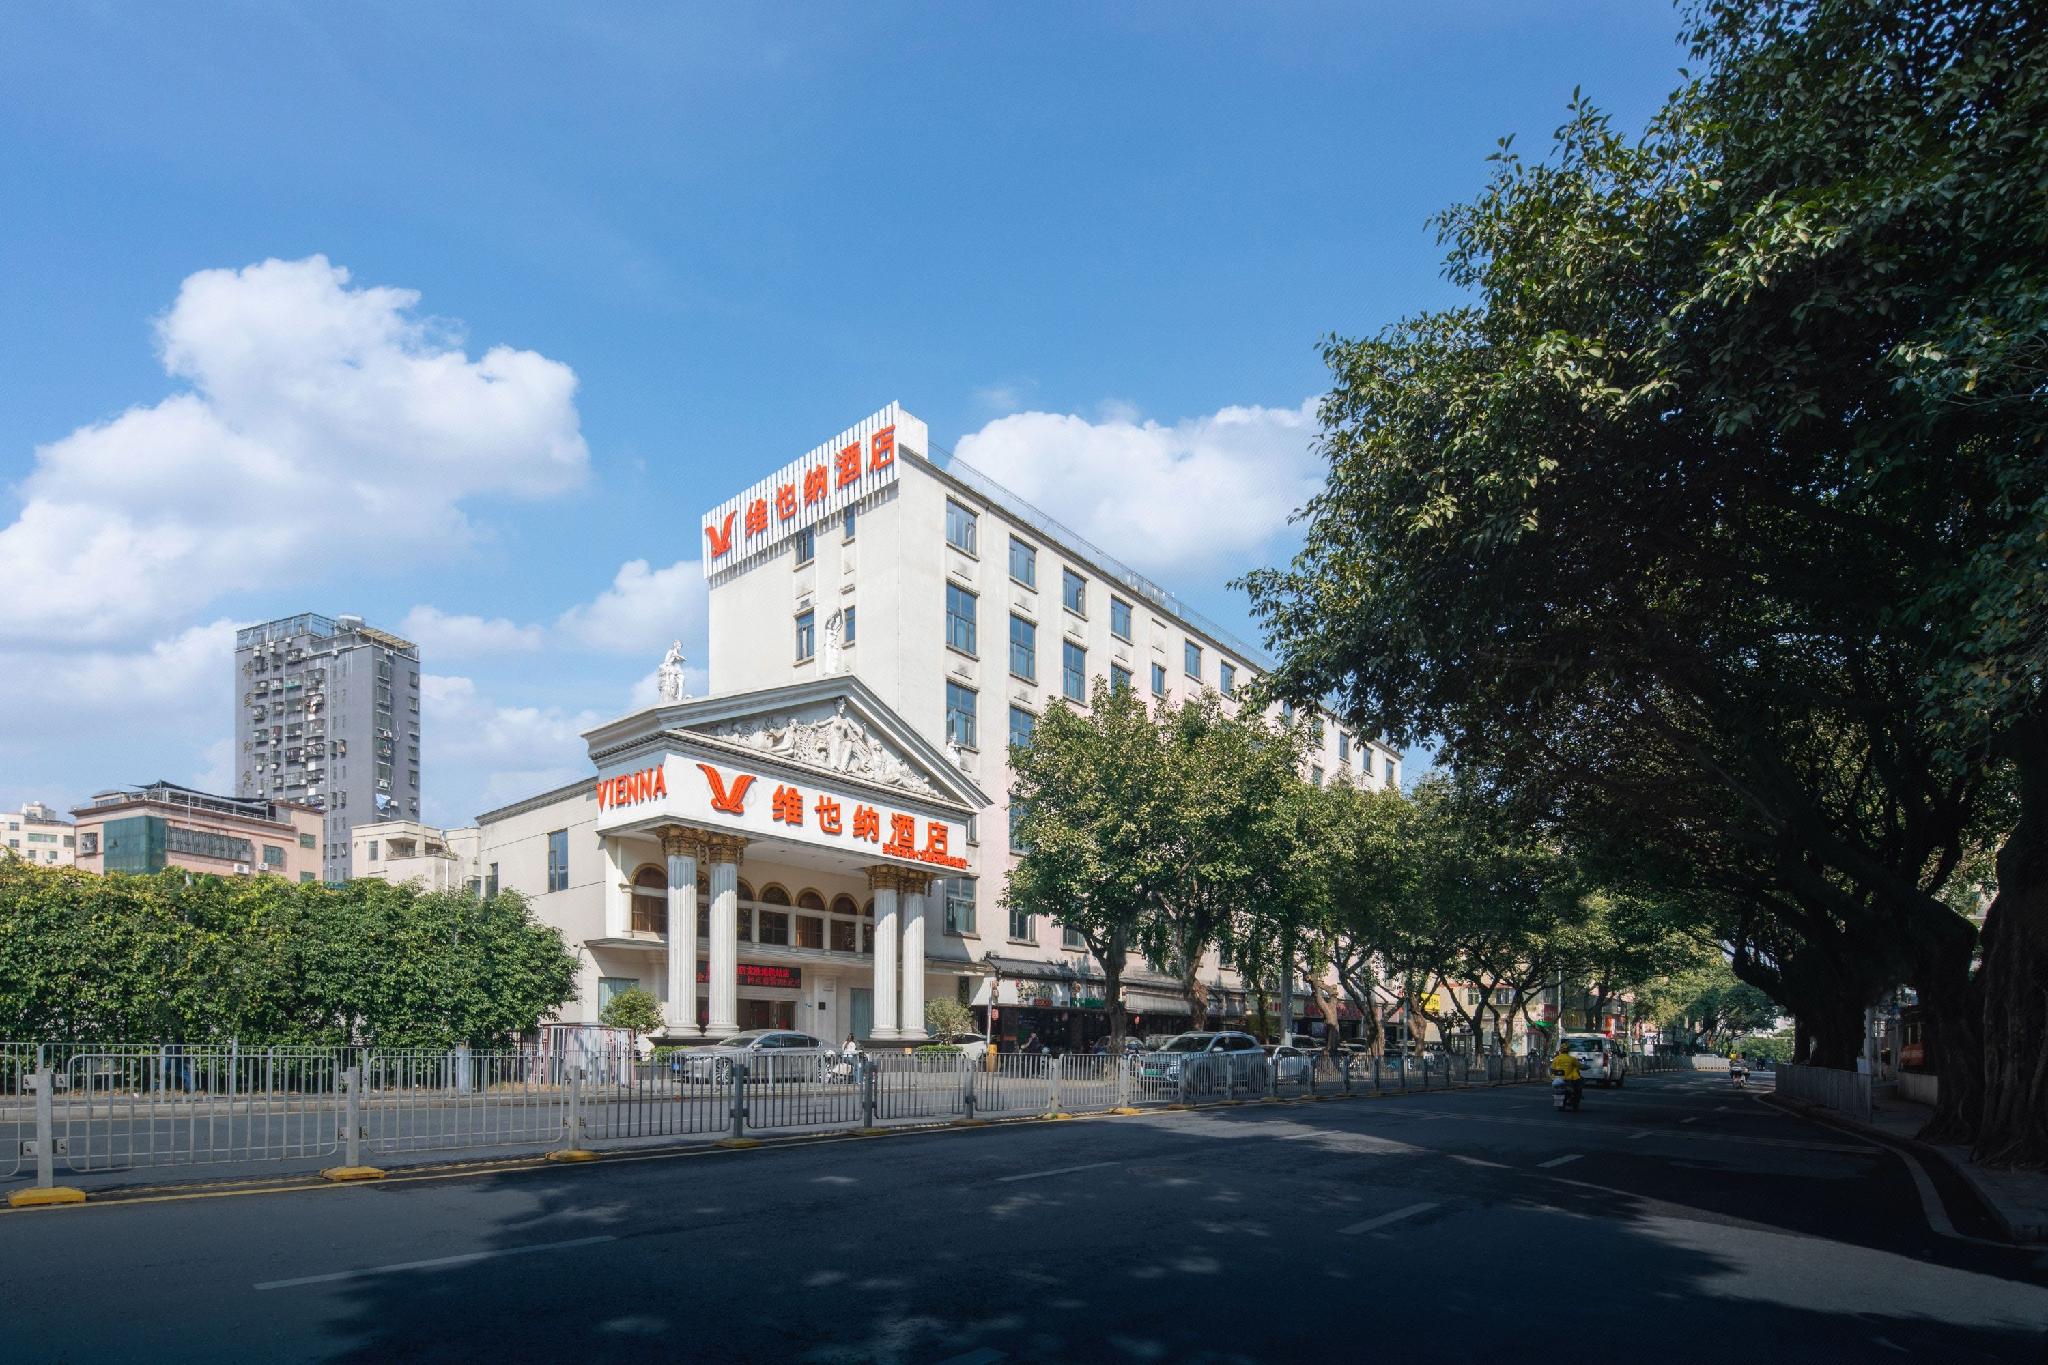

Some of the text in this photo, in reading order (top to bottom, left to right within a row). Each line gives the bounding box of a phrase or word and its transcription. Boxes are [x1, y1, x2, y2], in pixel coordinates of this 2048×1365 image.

[746, 424, 896, 538] 维也纳酒店
[596, 764, 667, 813] VIENNA
[772, 784, 950, 856] 维也纳酒店
